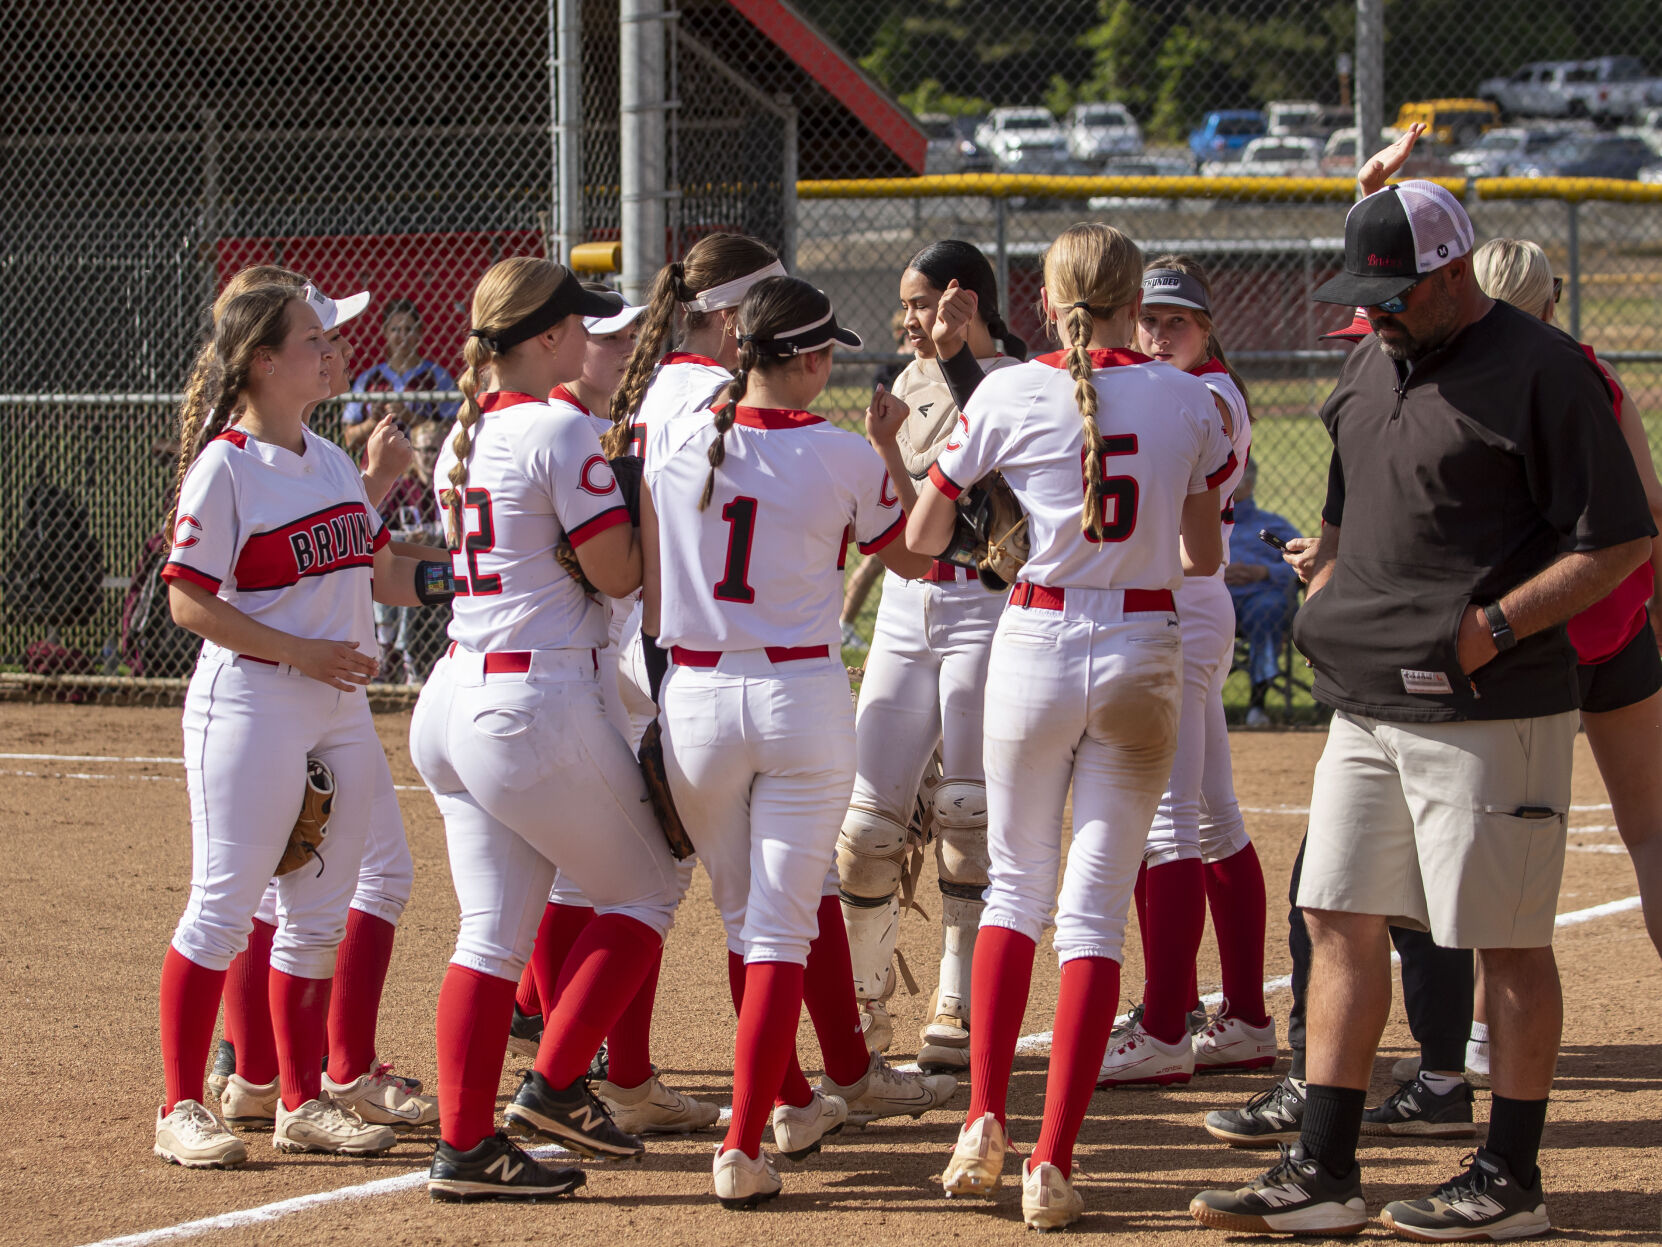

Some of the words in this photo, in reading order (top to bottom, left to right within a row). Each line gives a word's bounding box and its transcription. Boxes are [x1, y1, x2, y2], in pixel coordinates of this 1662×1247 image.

[576, 454, 616, 496] C
[1080, 434, 1139, 543] 6
[439, 487, 503, 596] 22
[713, 496, 758, 604] 1
